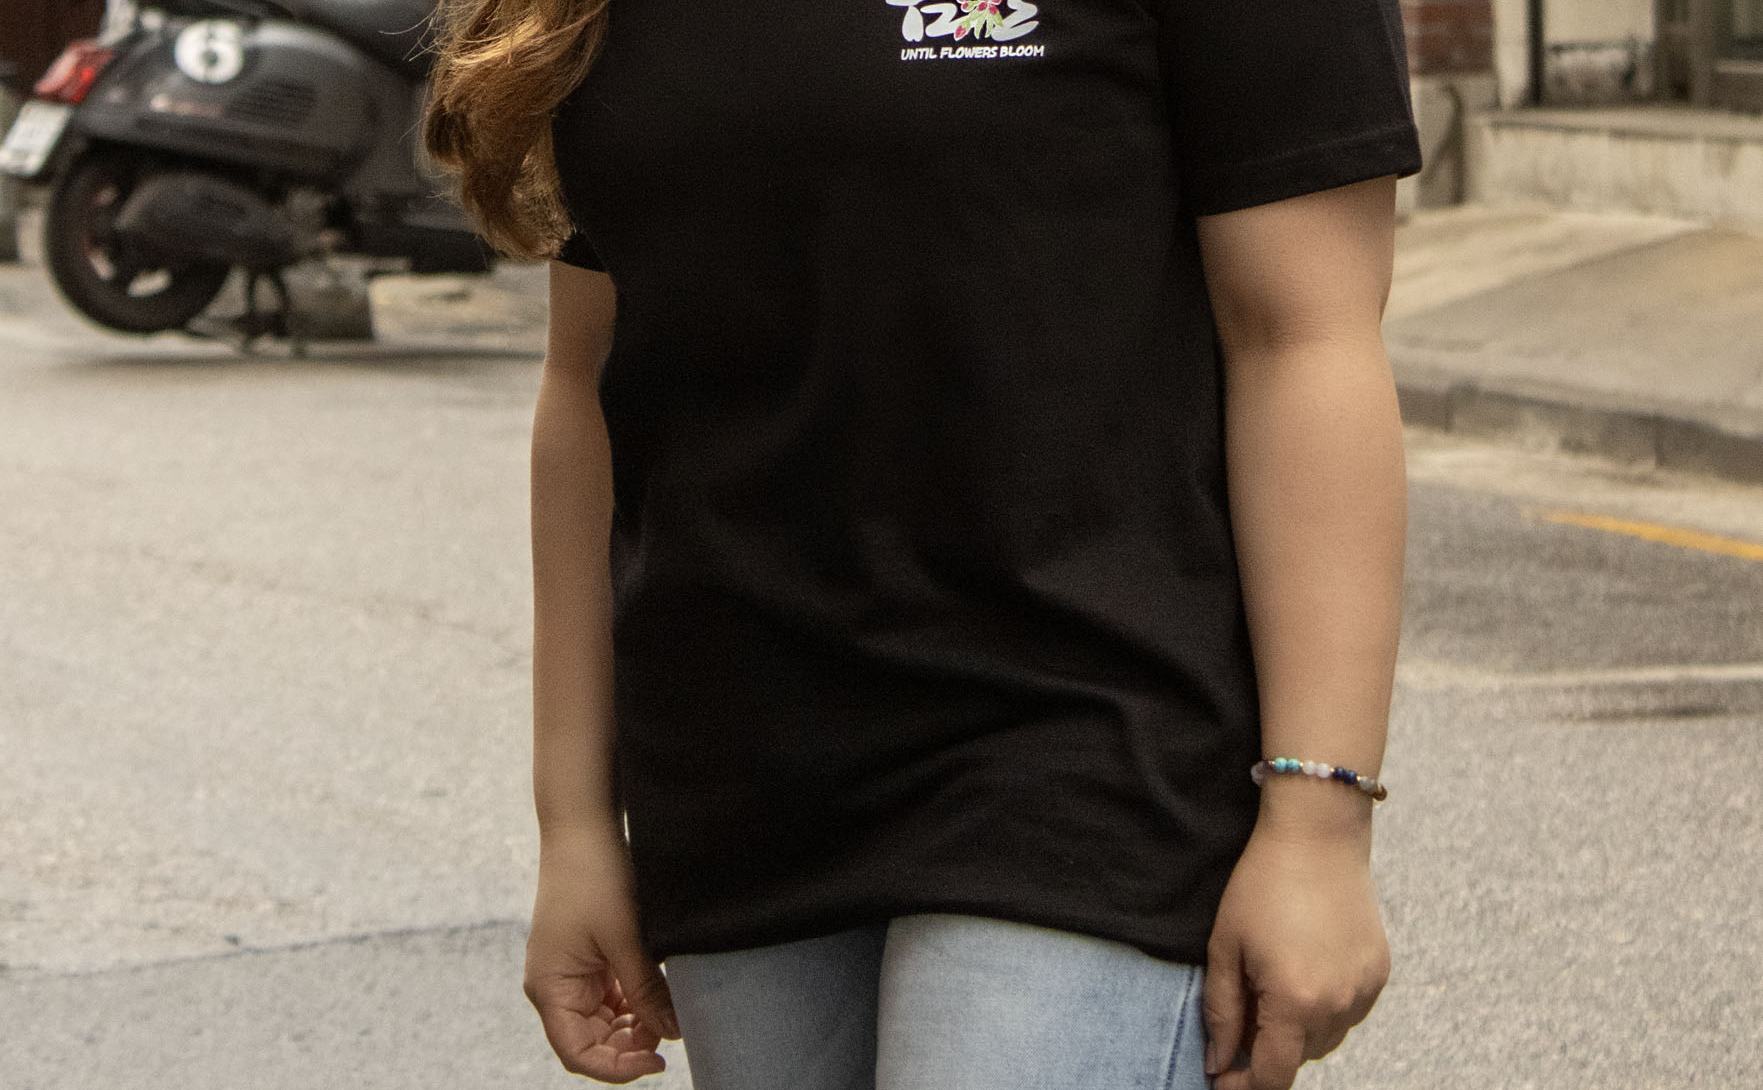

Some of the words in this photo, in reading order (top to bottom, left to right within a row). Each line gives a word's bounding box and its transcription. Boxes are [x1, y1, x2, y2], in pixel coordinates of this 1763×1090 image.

[175, 20, 242, 83] 6
[900, 47, 937, 60] UNTIL
[939, 46, 998, 59] FLOWERS
[999, 45, 1045, 58] BLOOM
